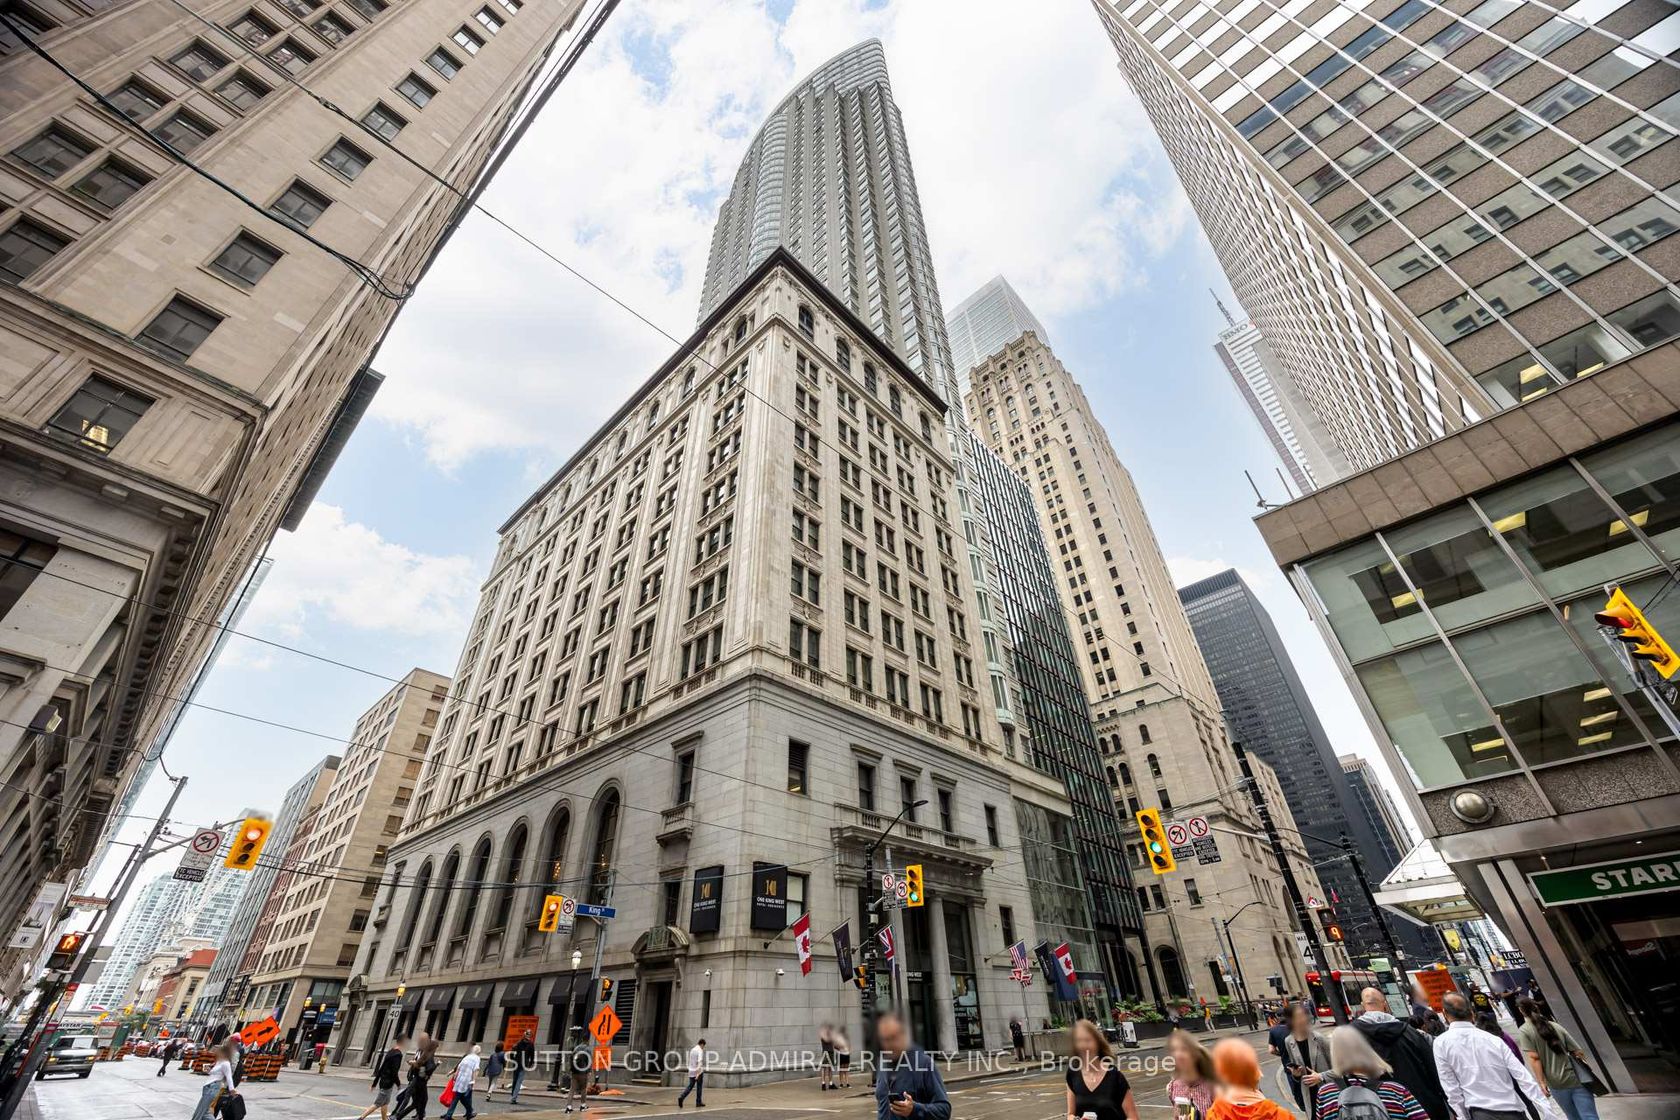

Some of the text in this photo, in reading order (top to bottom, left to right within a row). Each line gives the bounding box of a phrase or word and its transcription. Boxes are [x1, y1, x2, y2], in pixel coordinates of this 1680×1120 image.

[1222, 323, 1248, 340] BMO
[1591, 861, 1680, 890] STAR
[588, 906, 601, 916] King
[1331, 927, 1341, 939] 9
[1303, 946, 1314, 960] 4
[389, 1010, 399, 1018] 40
